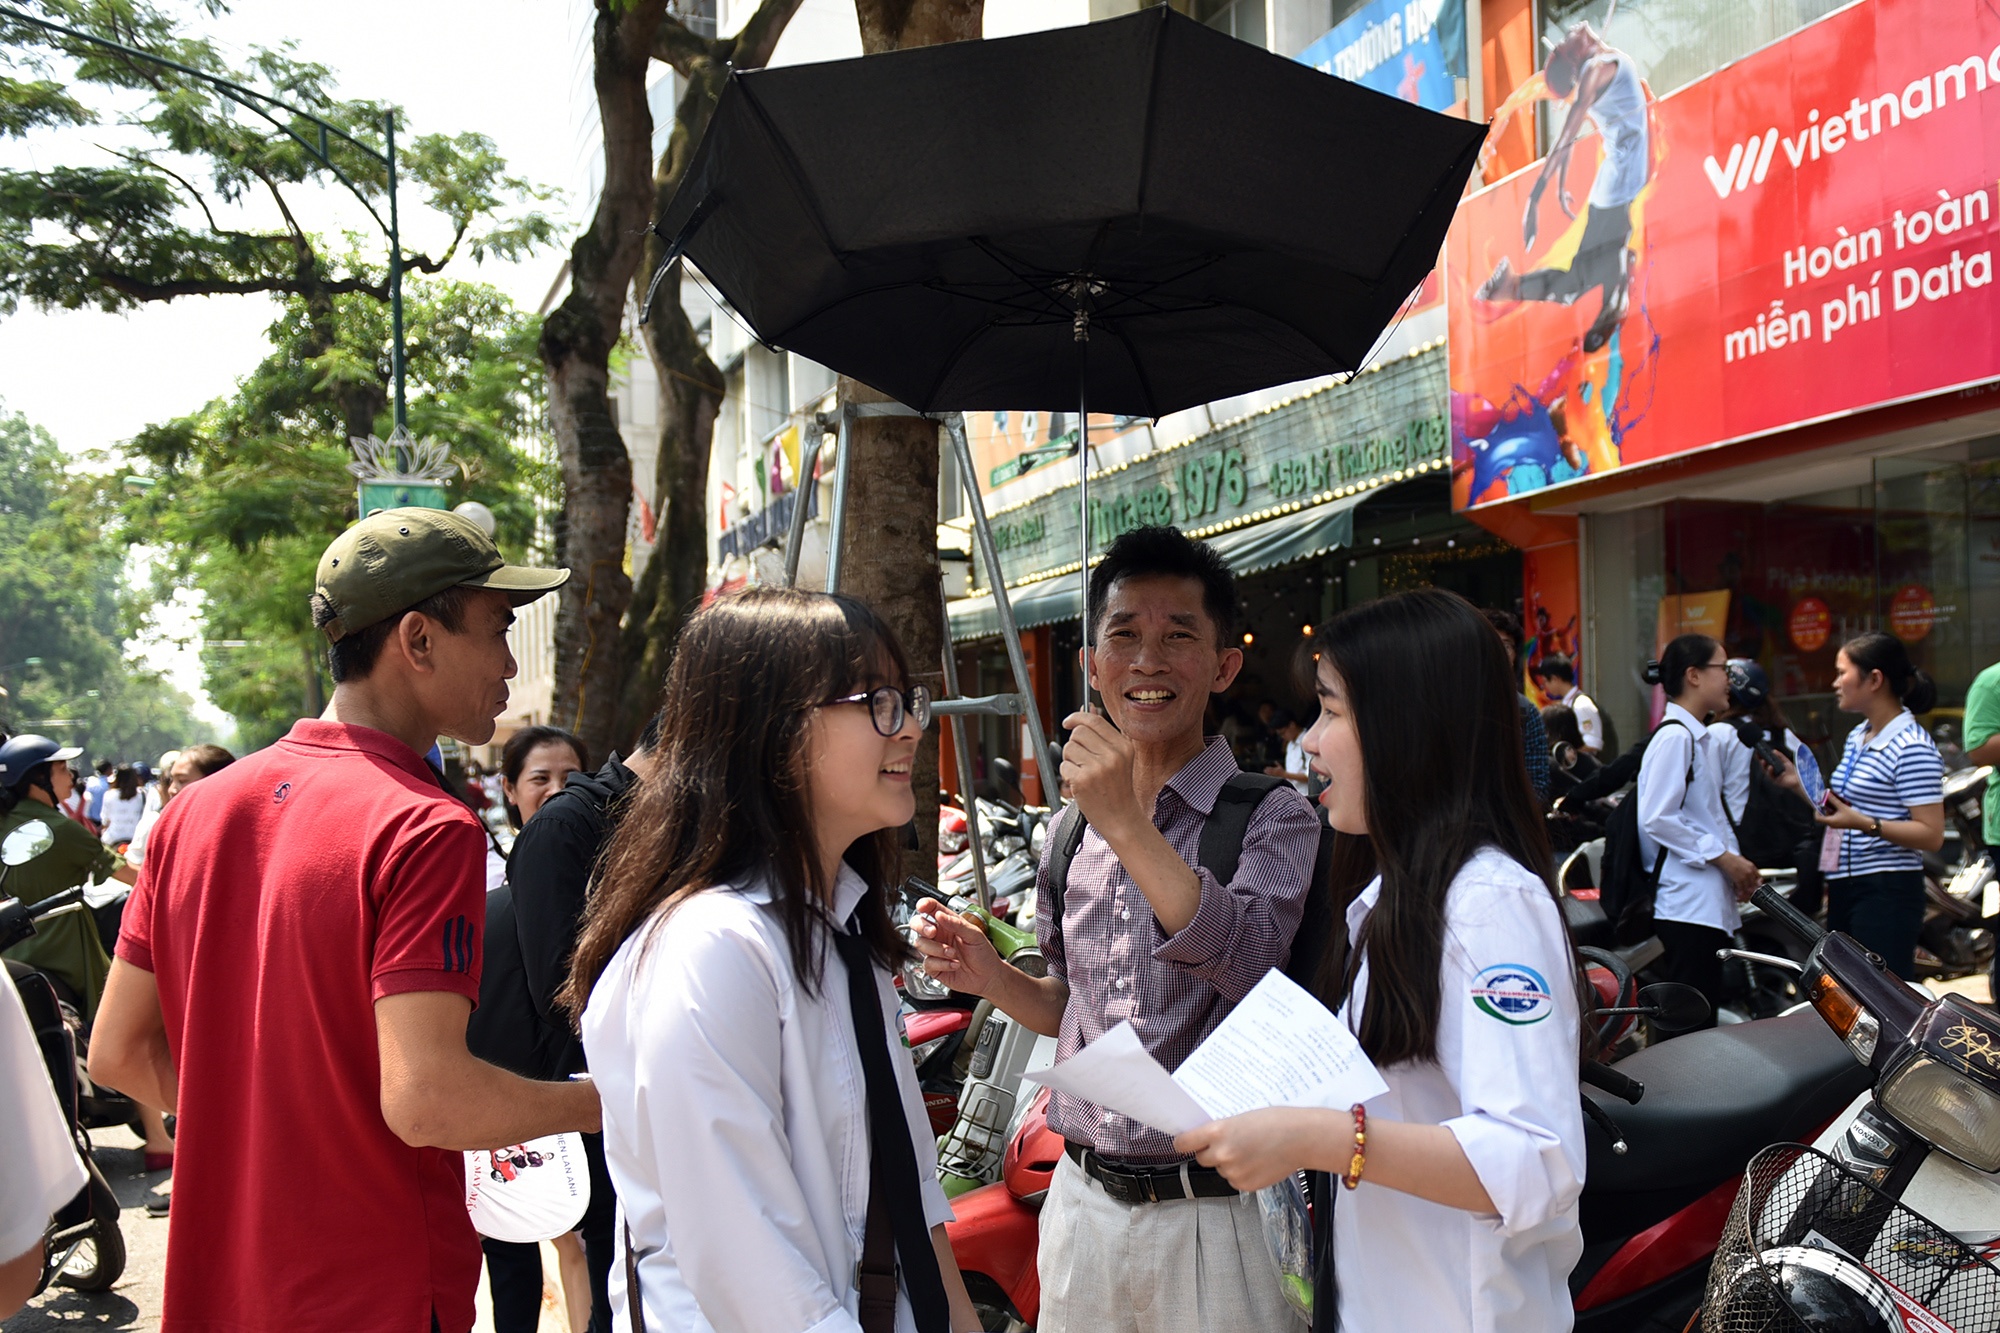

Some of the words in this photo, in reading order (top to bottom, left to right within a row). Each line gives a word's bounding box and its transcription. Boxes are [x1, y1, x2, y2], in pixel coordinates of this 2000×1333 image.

[1784, 226, 1882, 289] Hoàn
[1892, 188, 1990, 250] toàn
[1724, 299, 1811, 364] miễn
[1822, 270, 1882, 344] phí
[1893, 249, 1993, 312] Data
[1174, 448, 1249, 522] 1976
[1853, 1124, 1880, 1148] HONDA
[567, 1176, 578, 1197] ANH
